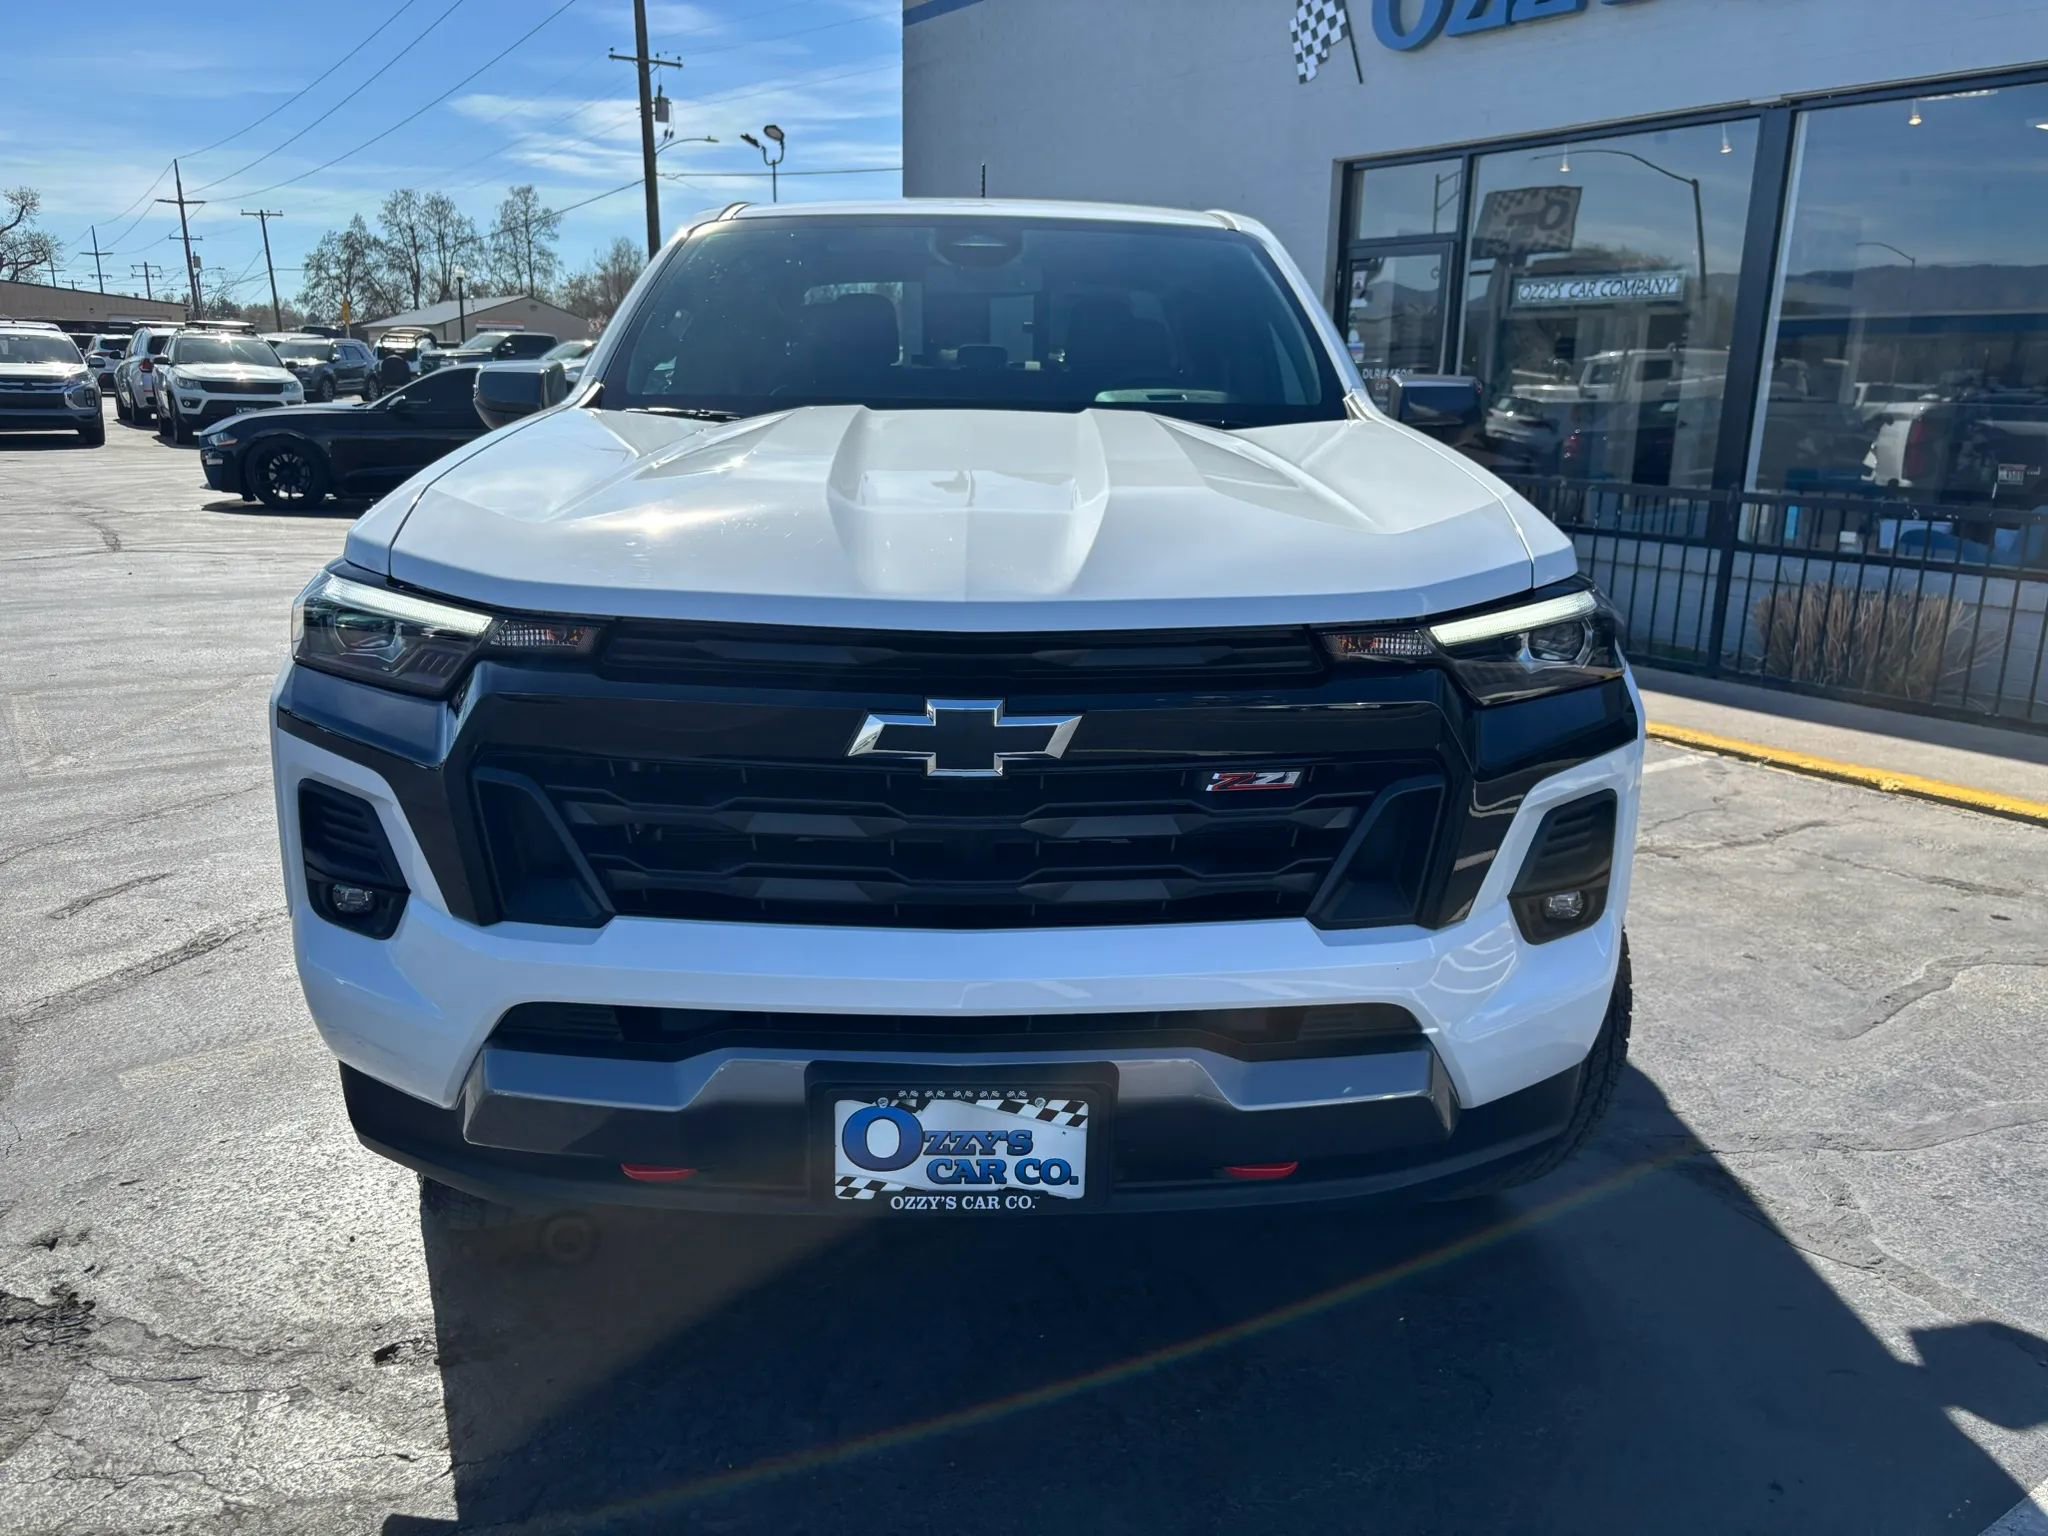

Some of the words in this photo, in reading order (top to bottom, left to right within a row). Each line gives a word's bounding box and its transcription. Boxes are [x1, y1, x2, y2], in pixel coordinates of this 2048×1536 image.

[1568, 282, 1596, 299] CAR
[1599, 277, 1675, 297] COMPANY
[1206, 771, 1301, 791] Z71
[842, 1107, 1033, 1171] OZZY'S
[926, 1158, 1007, 1185] CAR
[1014, 1158, 1079, 1185] CO.
[890, 1196, 957, 1210] OZZY'S
[961, 1196, 1001, 1210] CAR
[1005, 1195, 1036, 1210] CO.
